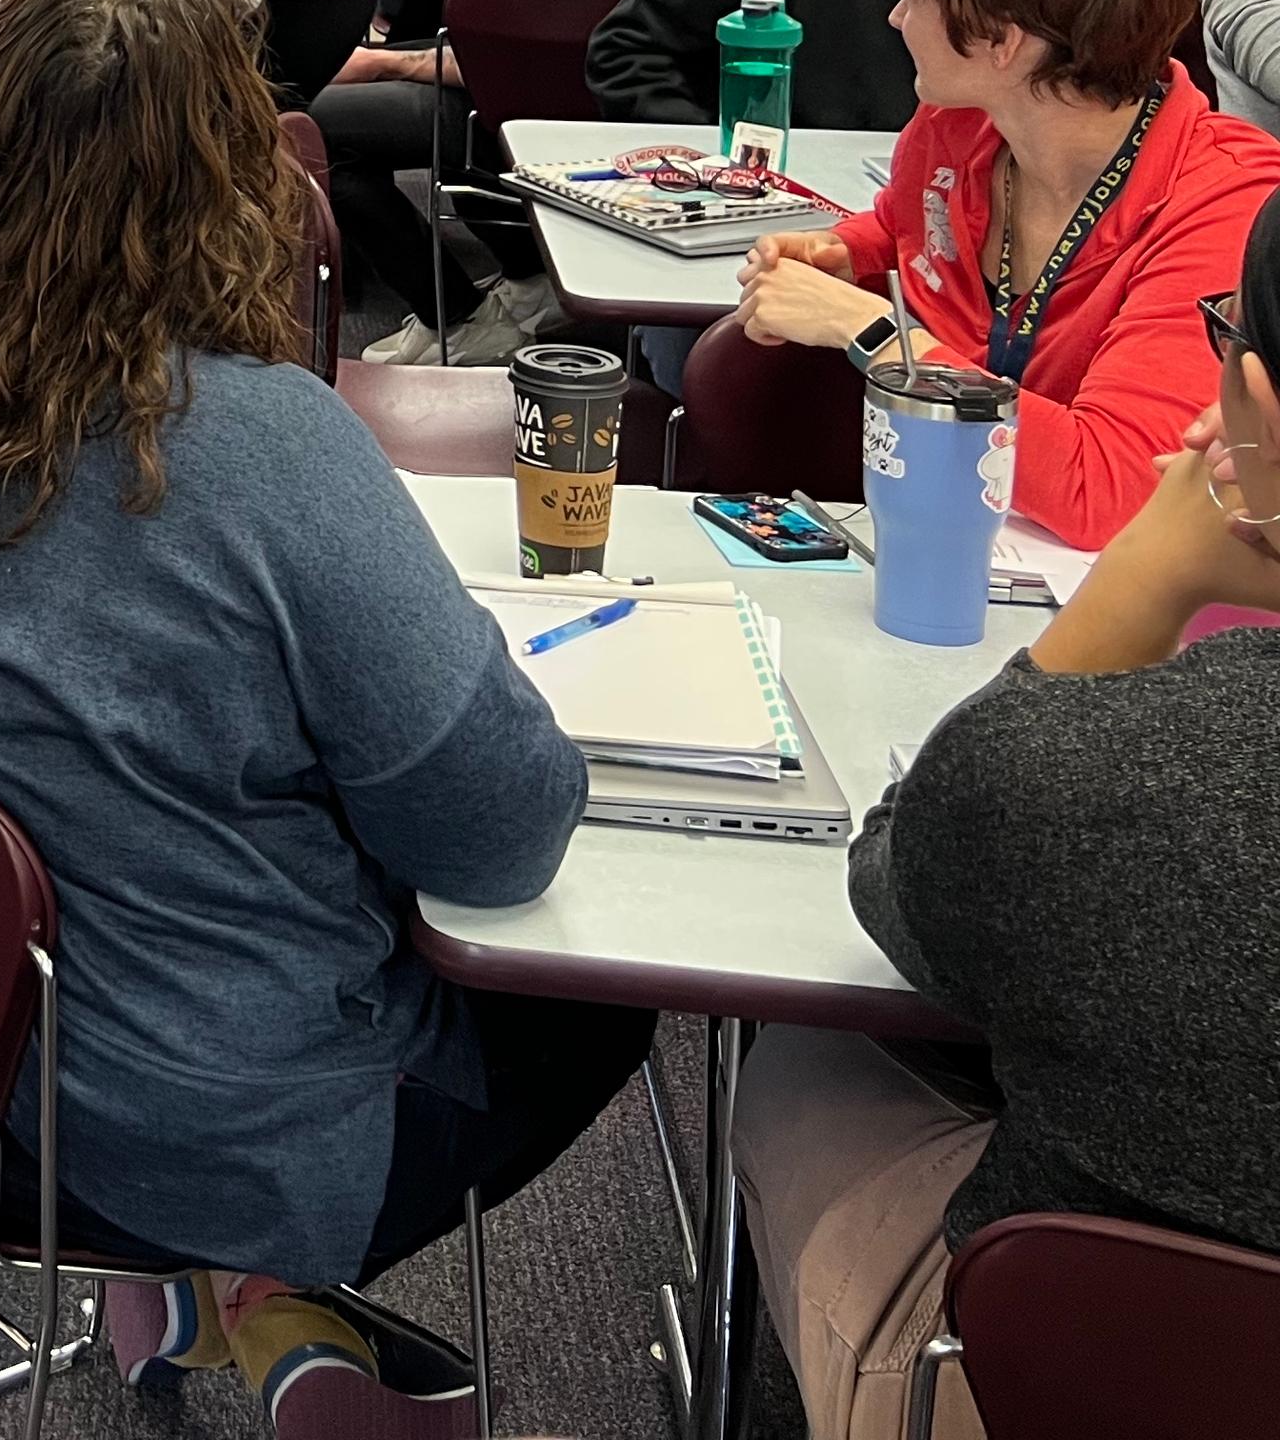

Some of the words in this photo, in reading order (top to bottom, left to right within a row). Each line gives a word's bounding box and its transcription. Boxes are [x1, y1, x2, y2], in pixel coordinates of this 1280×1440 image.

[1017, 97, 1162, 335] www.navyjobs.com
[996, 243, 1011, 318] NAVY
[562, 502, 609, 522] WAVE
[566, 482, 613, 503] JAVA
